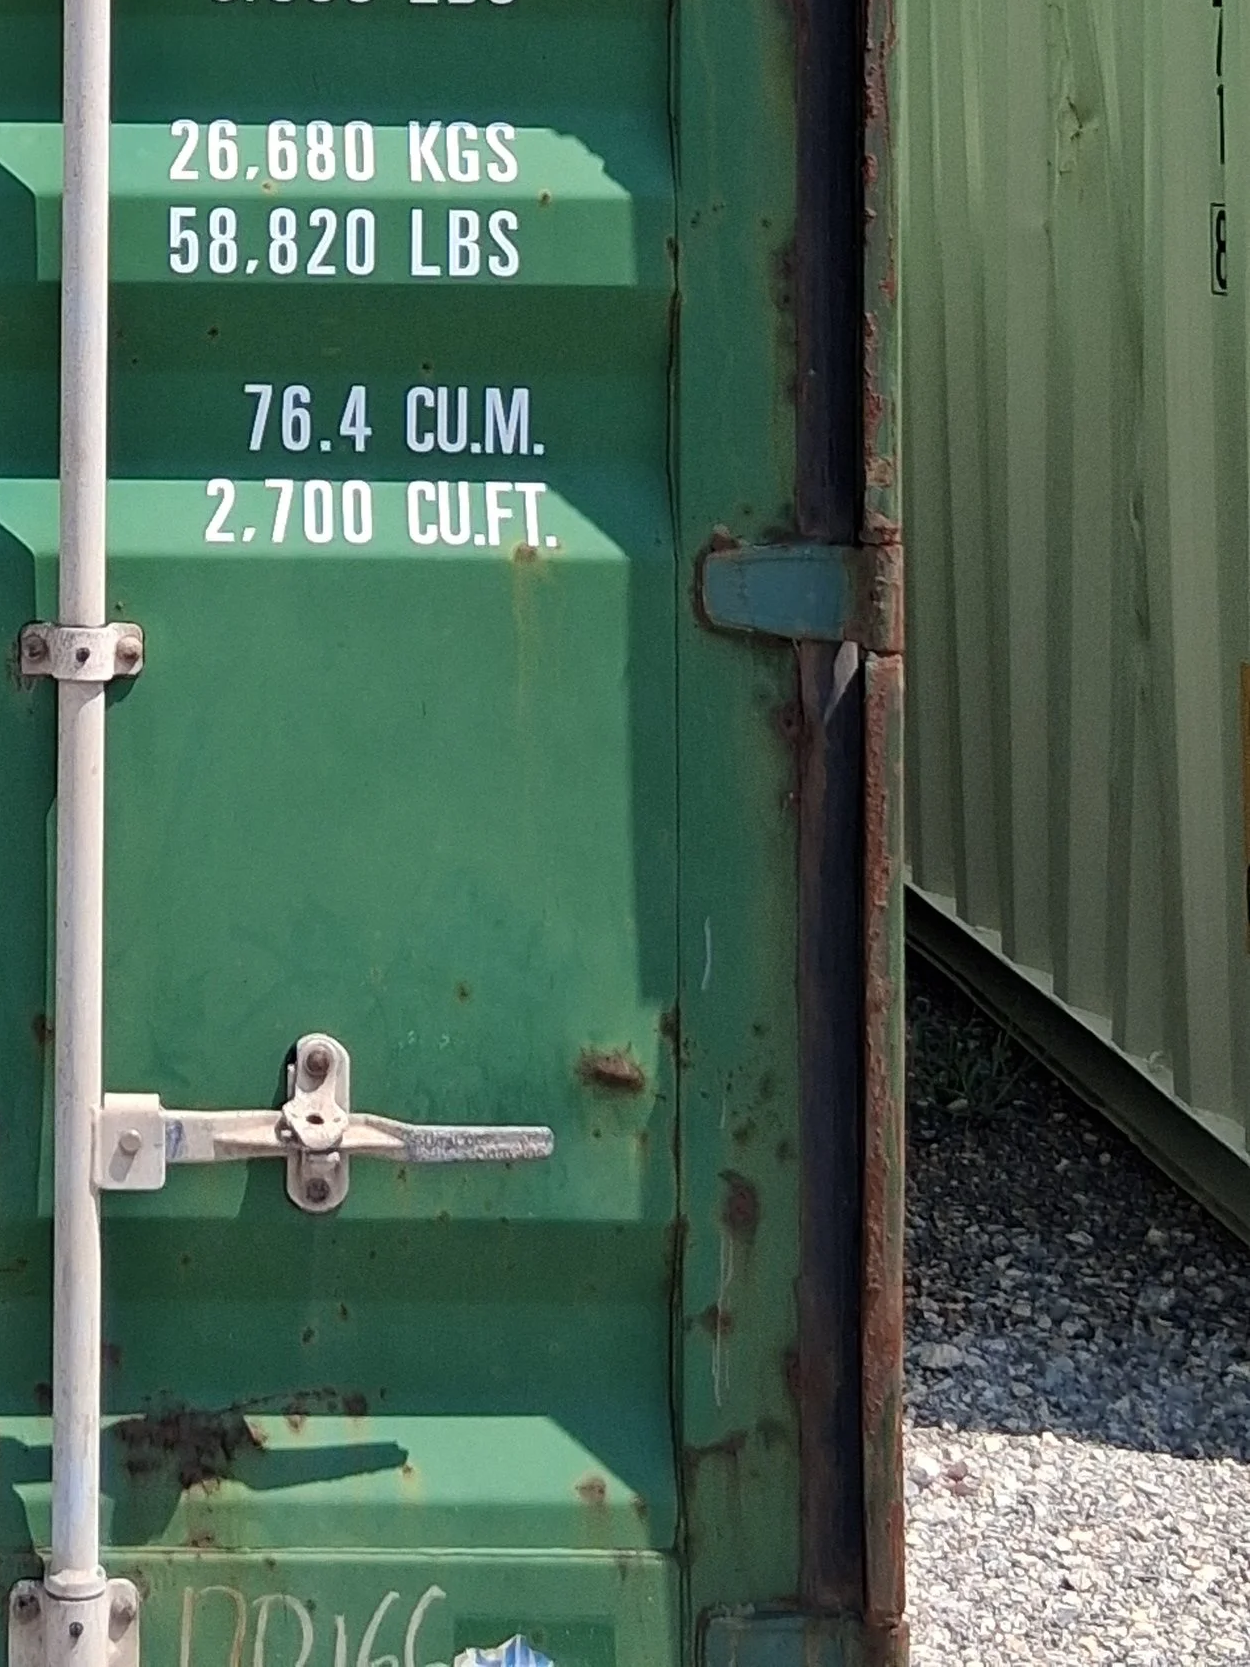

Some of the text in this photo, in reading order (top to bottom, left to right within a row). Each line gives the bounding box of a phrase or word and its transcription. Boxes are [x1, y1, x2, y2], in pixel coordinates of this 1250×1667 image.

[408, 121, 519, 183] KGS
[410, 209, 520, 277] LBS
[244, 384, 546, 455] 76.4 CU.M.
